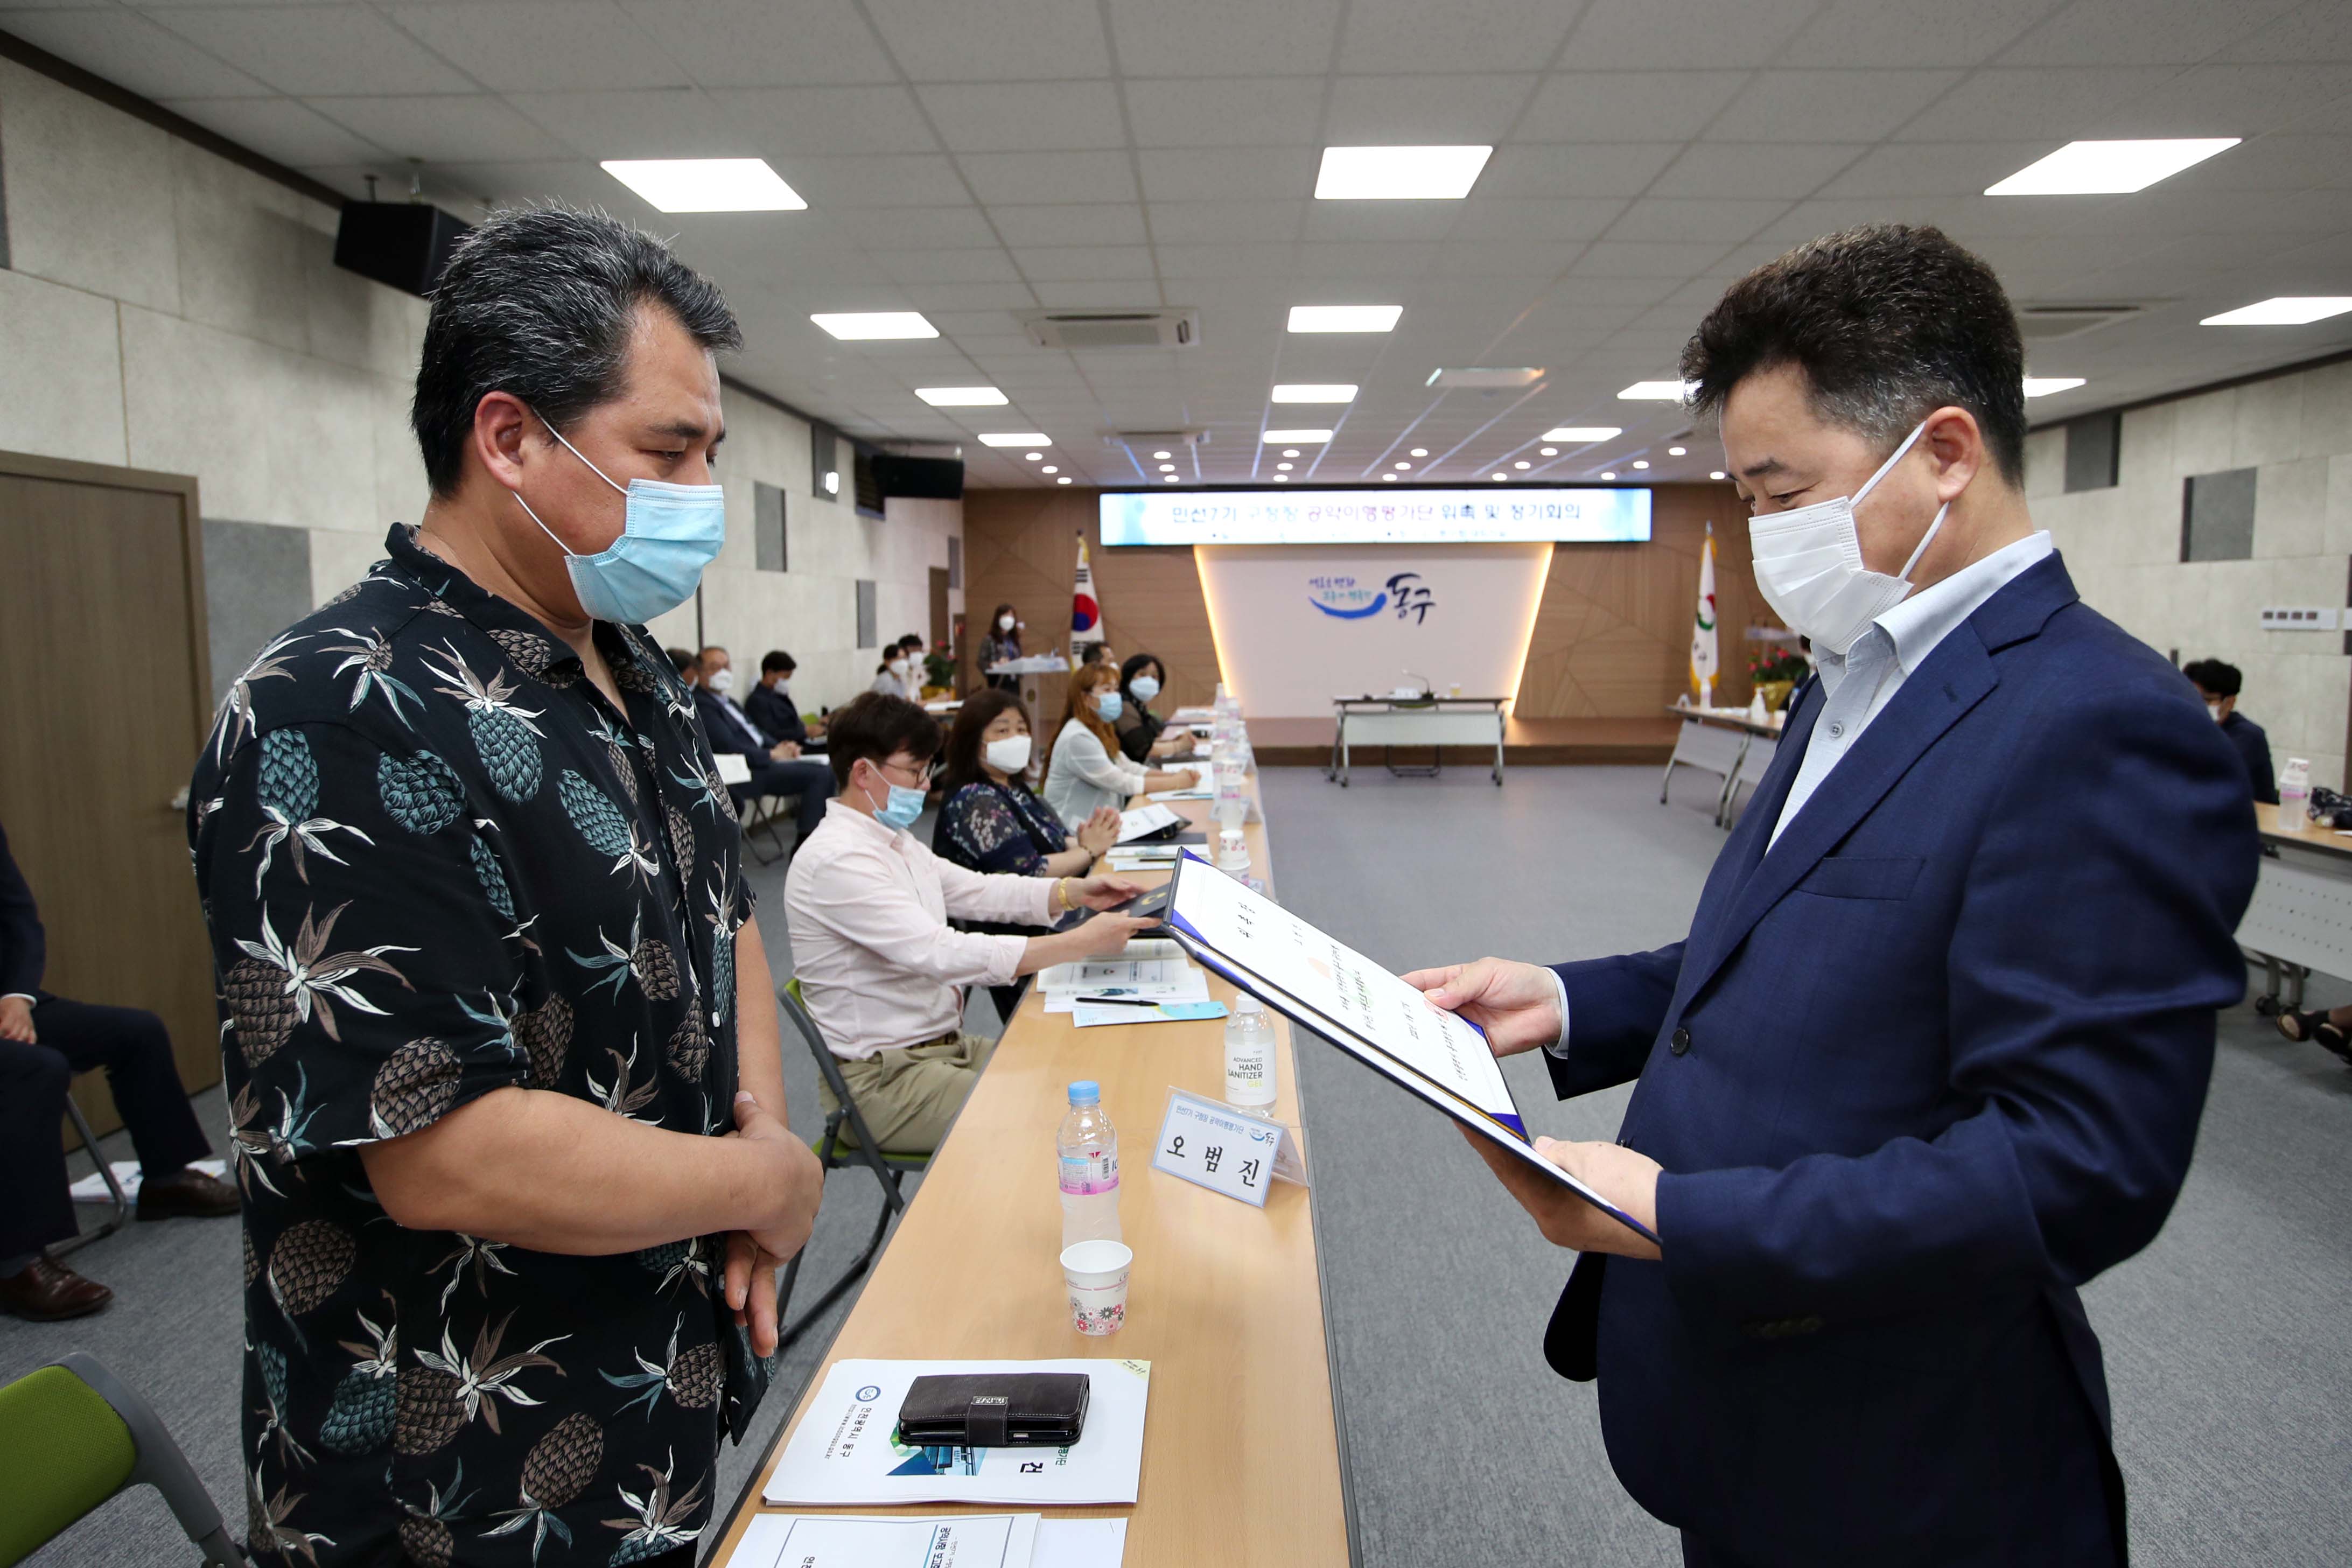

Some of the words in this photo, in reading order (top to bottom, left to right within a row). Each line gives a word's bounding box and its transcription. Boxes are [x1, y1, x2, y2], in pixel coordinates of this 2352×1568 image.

[1172, 506, 1237, 523] 민선7기
[1386, 572, 1437, 626] 동구
[1166, 1135, 1185, 1158] 오
[1205, 1146, 1223, 1172] 범
[1238, 1159, 1259, 1187] 진
[848, 1407, 872, 1439] 인천광역시
[840, 1444, 854, 1457] 동구
[1055, 1445, 1070, 1465] 평가단
[1020, 1462, 1044, 1473] 건
[935, 1527, 951, 1550] 공약사항
